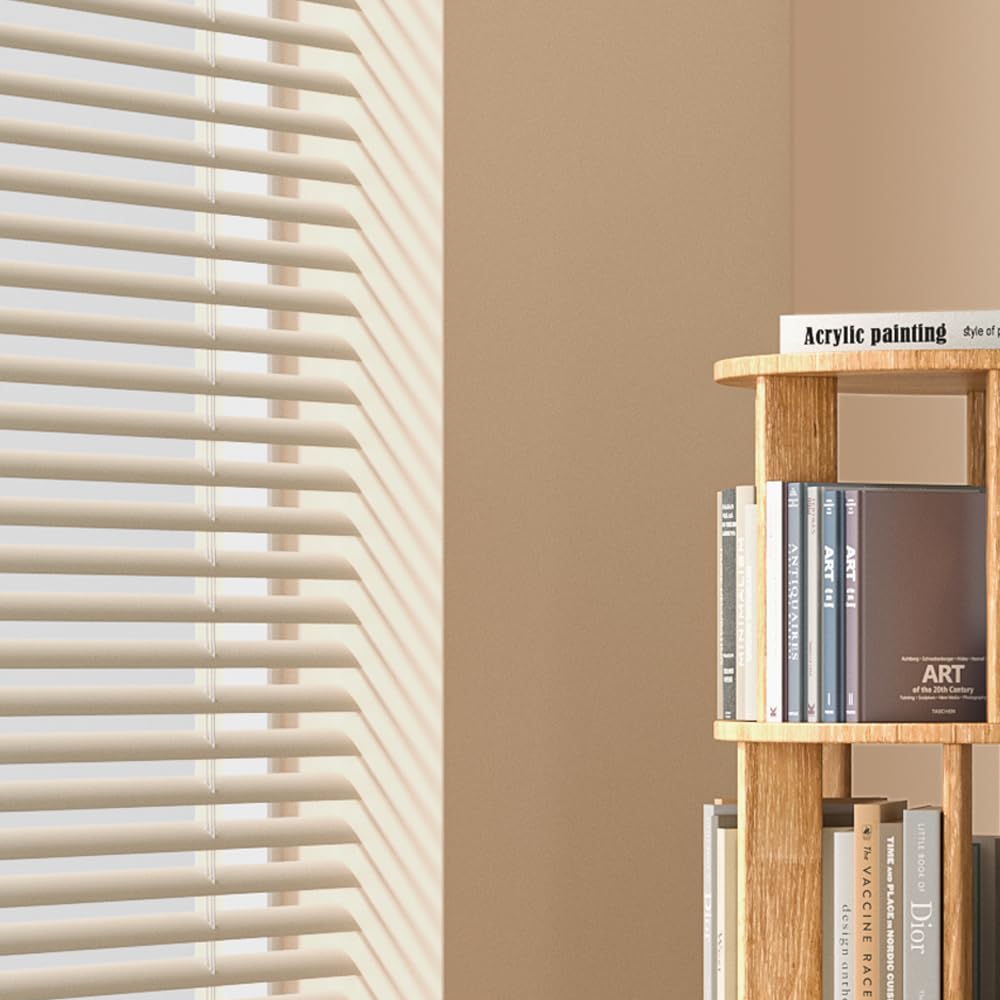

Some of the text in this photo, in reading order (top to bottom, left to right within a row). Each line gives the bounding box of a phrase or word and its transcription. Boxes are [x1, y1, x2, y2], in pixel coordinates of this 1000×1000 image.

[804, 325, 866, 347] Acrylic
[870, 323, 948, 346] painting
[963, 325, 985, 338] style
[986, 324, 995, 337] of
[824, 545, 835, 582] ART
[845, 545, 857, 582] ART
[791, 543, 799, 661] ANTIQUAIRES
[912, 686, 975, 696] of the 20th Century
[922, 664, 966, 684] ART
[886, 836, 895, 865] TIME
[886, 883, 895, 920] PLACE
[839, 904, 852, 956] design
[863, 846, 873, 998] The VACCINE RACE
[910, 900, 933, 955] Dior
[886, 929, 895, 972] NORDIC
